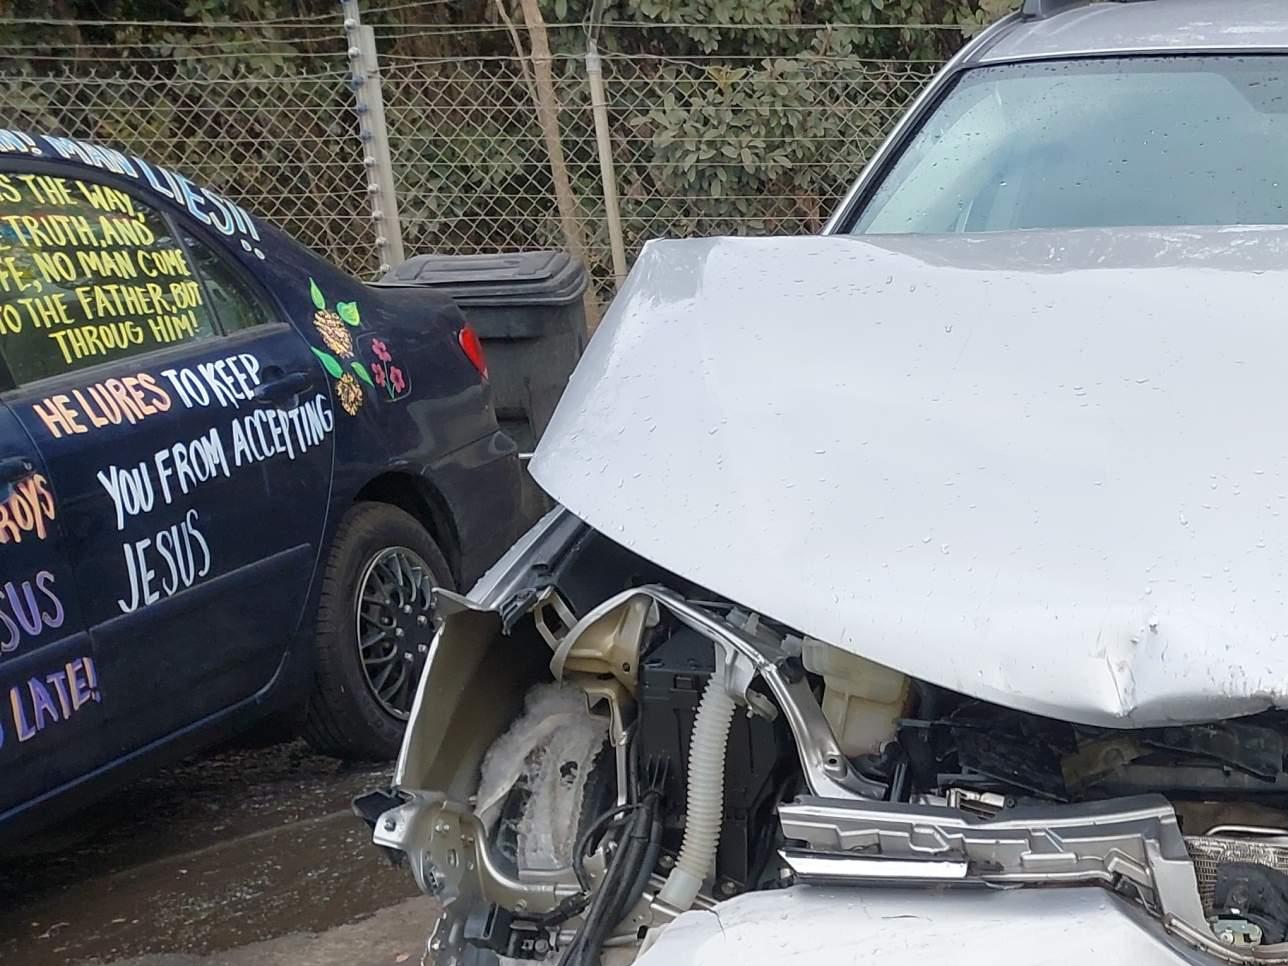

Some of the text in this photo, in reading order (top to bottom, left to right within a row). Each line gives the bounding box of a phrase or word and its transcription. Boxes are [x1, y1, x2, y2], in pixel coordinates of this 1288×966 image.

[40, 134, 139, 178] MAN
[17, 174, 78, 206] THE
[77, 180, 145, 222] WAY,
[32, 251, 77, 283] NO
[75, 250, 138, 280] MAN
[137, 248, 192, 278] COME
[17, 293, 75, 329] THE
[48, 310, 201, 364] THROUG HIM!
[33, 353, 261, 438] HE LURES TO KEEP
[96, 394, 334, 531] YOU FROM ACCEPTING
[118, 508, 211, 613] JESUS
[9, 656, 101, 742] LATE!
